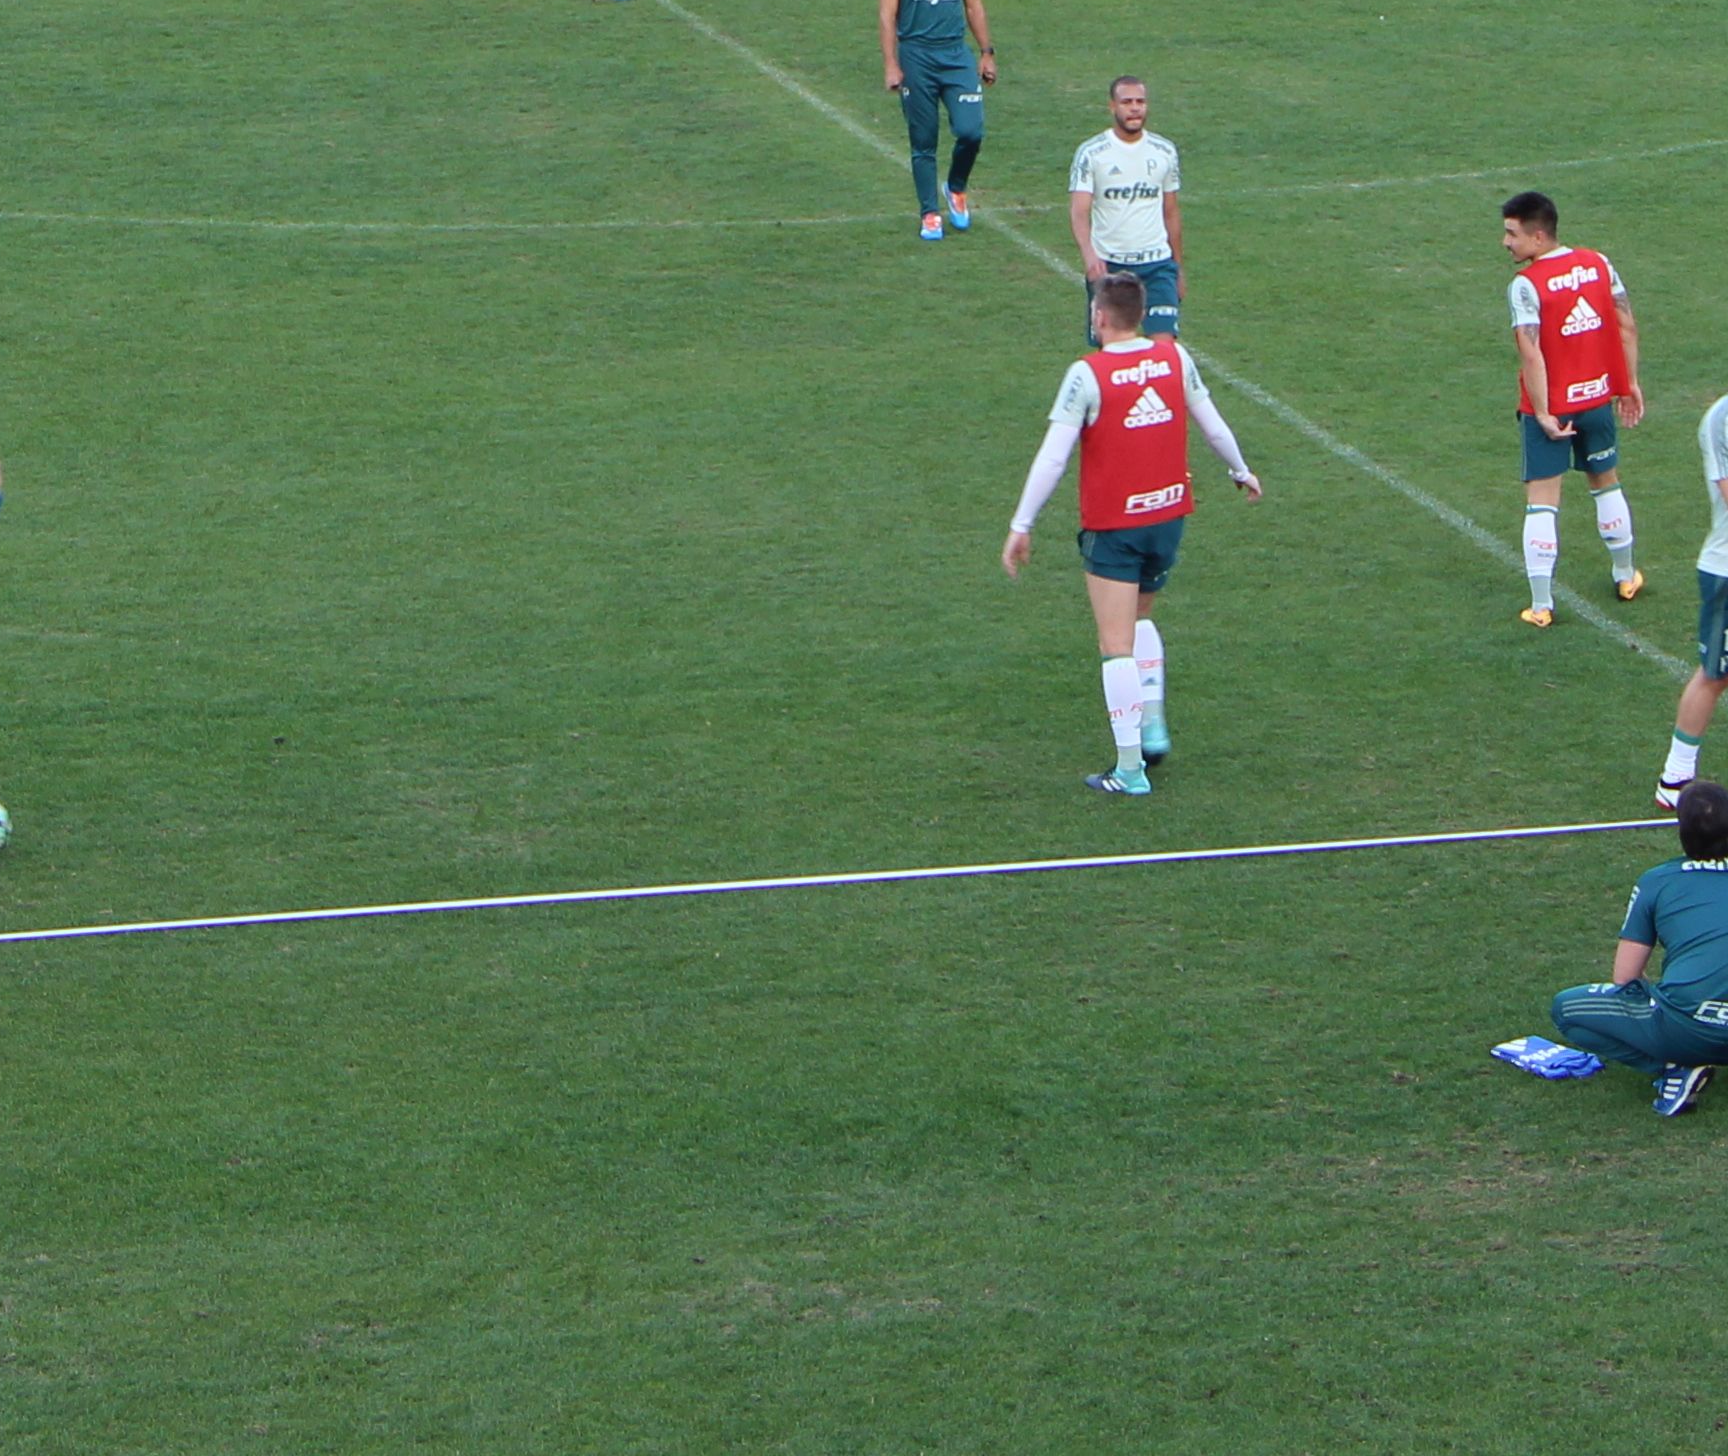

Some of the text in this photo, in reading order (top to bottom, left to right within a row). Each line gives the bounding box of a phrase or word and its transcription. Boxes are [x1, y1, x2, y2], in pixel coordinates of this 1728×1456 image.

[1104, 182, 1159, 204] crefisa
[1111, 359, 1172, 386] crefisa
[1123, 409, 1173, 429] adidas
